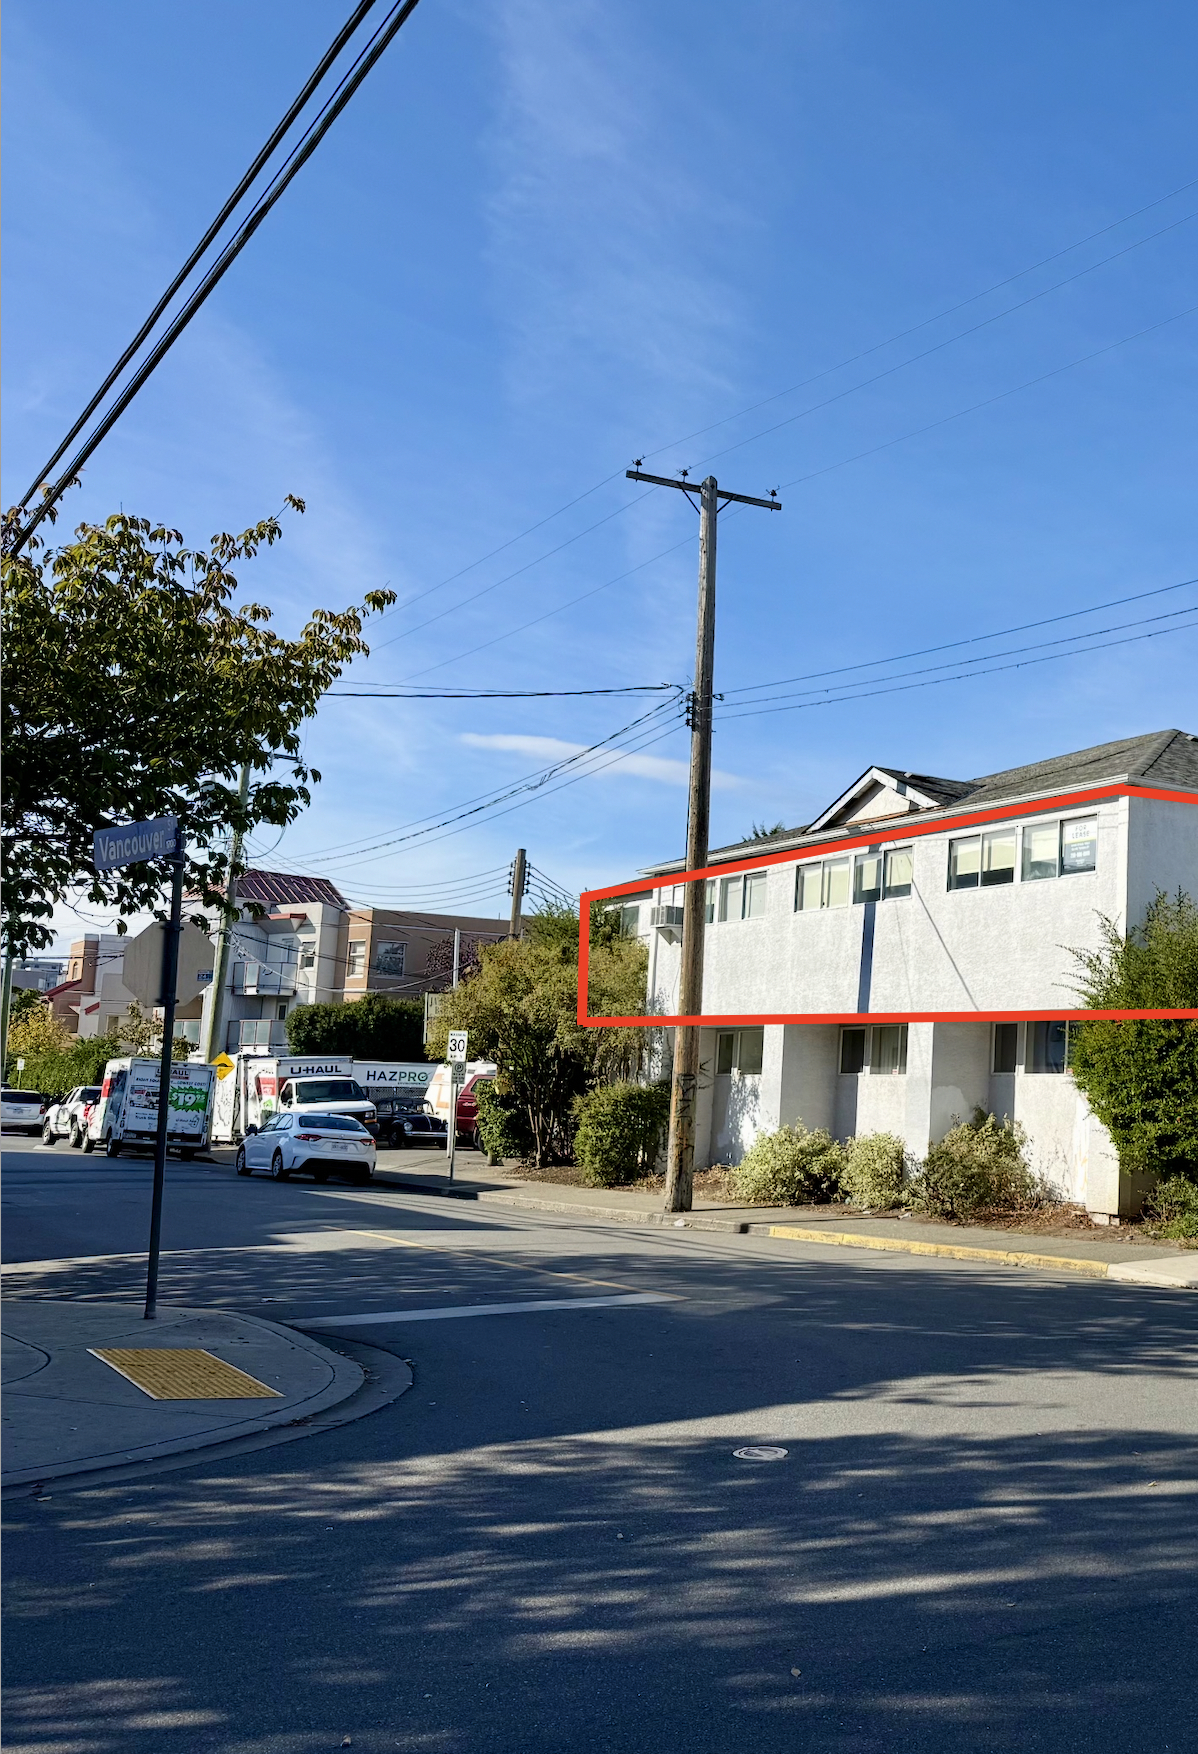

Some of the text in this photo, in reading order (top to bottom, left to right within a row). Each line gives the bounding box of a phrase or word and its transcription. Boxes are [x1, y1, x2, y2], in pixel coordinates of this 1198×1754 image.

[1072, 830, 1090, 839] LEASE
[98, 830, 164, 862] Vancouver
[449, 1038, 465, 1052] 30
[290, 1065, 342, 1075] U-HAUL
[366, 1070, 429, 1081] HAZPRO
